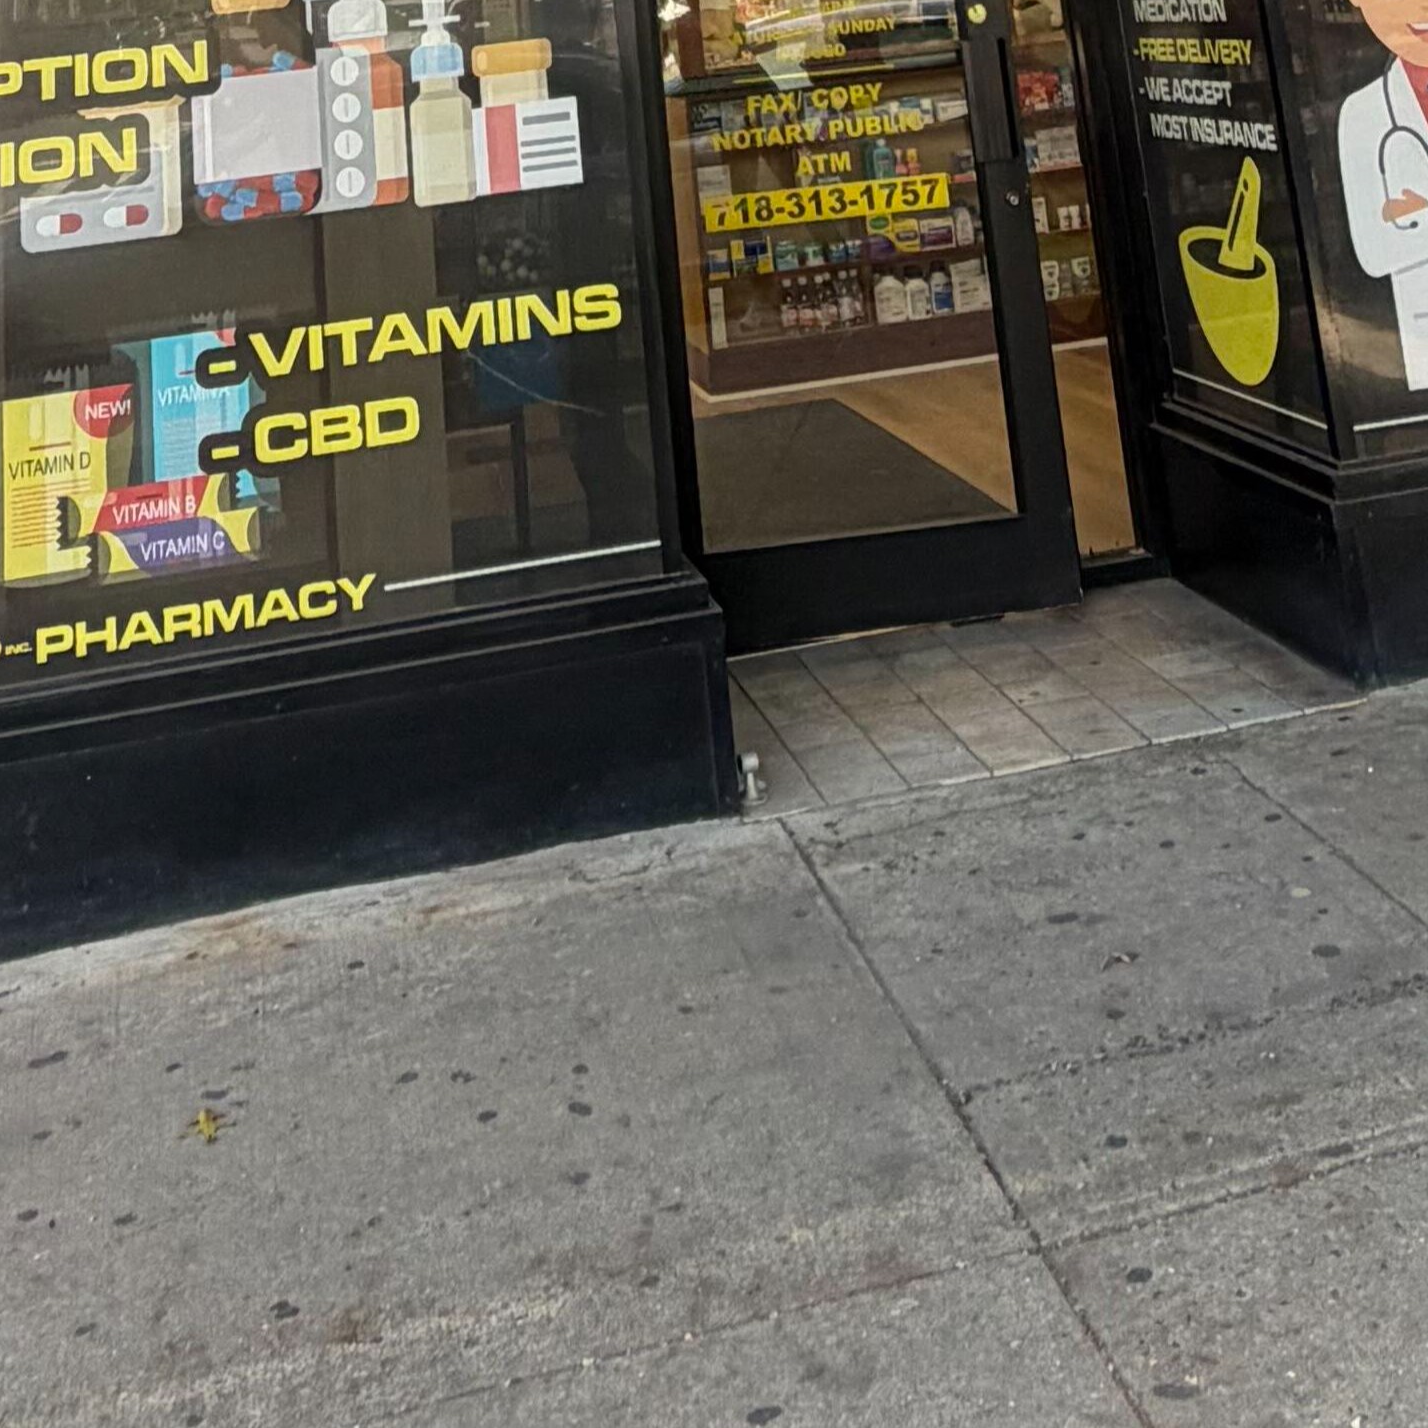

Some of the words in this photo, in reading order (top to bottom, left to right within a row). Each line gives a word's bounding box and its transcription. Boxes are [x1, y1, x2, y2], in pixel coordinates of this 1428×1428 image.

[1177, 38, 1252, 65] DELIVERY
[811, 82, 882, 111] COPY
[1172, 77, 1233, 108] ACCEPT
[710, 123, 822, 152] NOTARY
[828, 111, 924, 141] PUBLIC
[1150, 113, 1189, 140] MOST
[1191, 114, 1278, 151] INSURANCE
[796, 151, 852, 176] ATM
[711, 178, 942, 228] 718-313-1757
[246, 281, 624, 380] VITAMINS
[84, 399, 132, 422] NEW!
[254, 395, 423, 467] CBD
[8, 453, 75, 480] VITAMIN
[79, 451, 91, 470] D
[112, 496, 180, 525] VITAMIN
[184, 495, 197, 514] B
[140, 533, 209, 562] VITAMIN
[212, 531, 225, 549] C
[35, 574, 377, 665] PHARMACY
